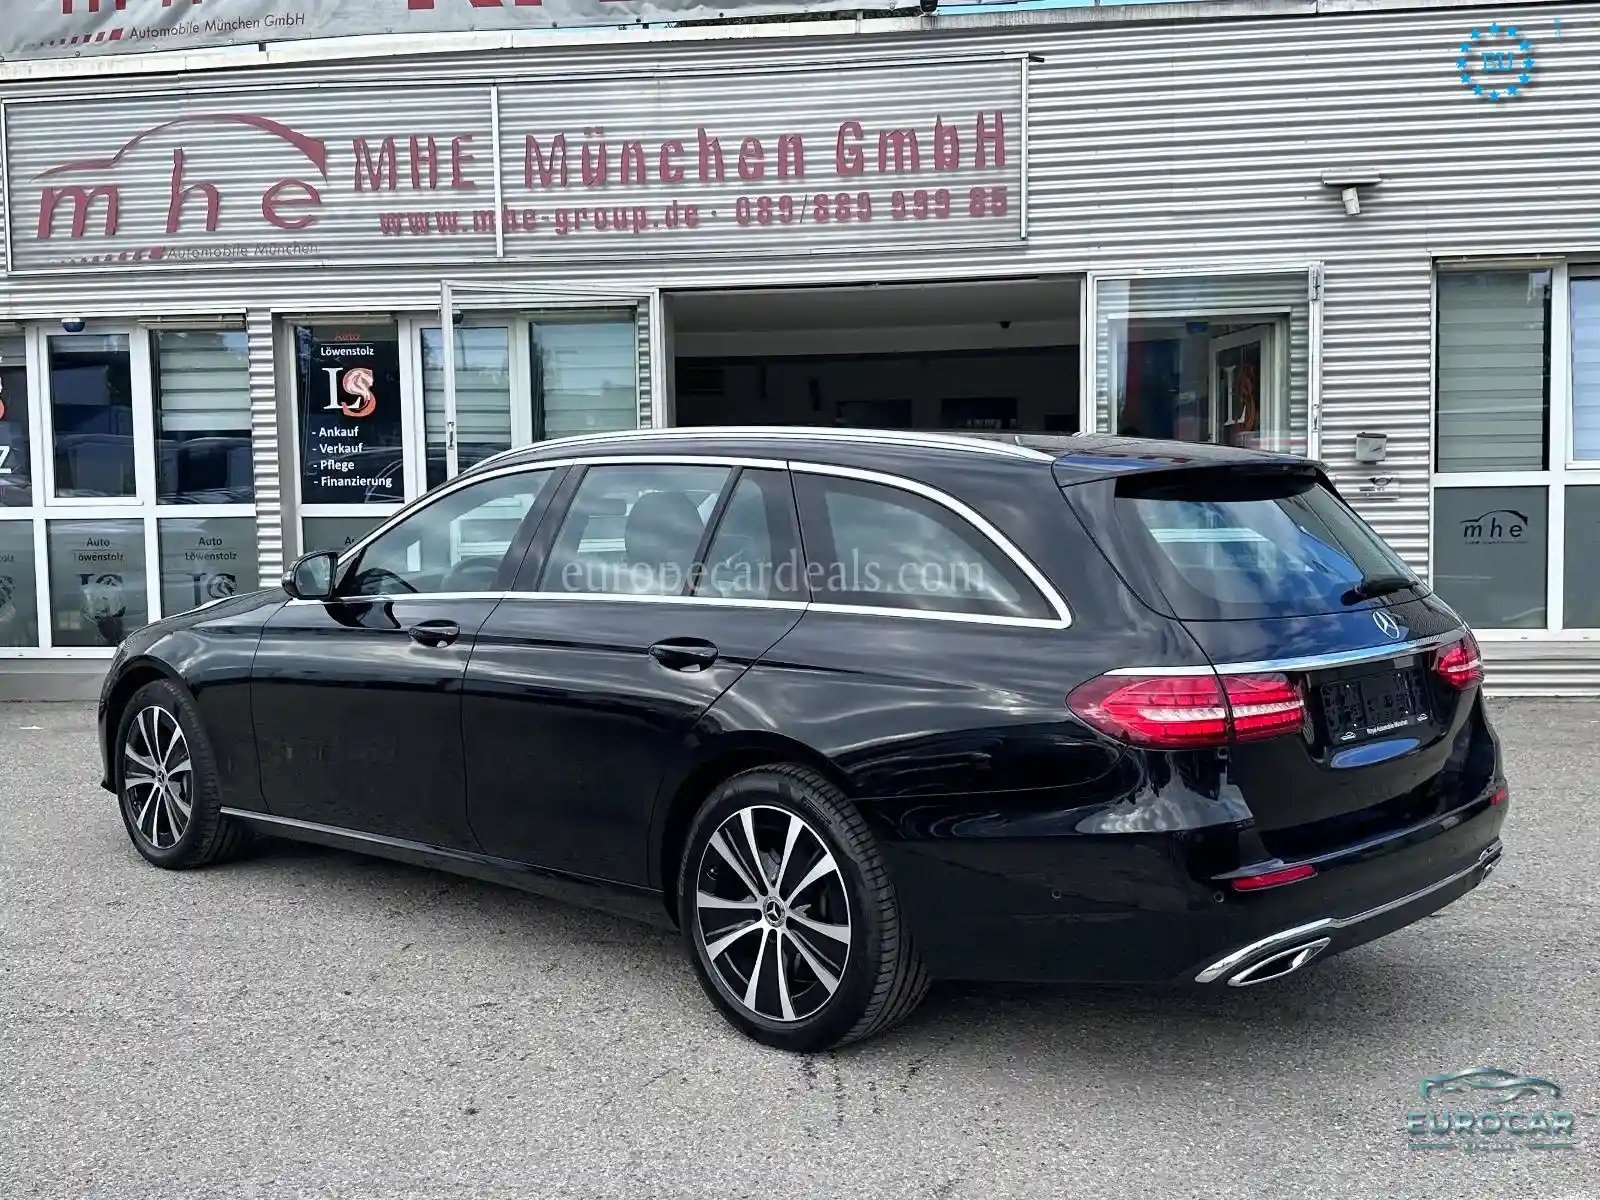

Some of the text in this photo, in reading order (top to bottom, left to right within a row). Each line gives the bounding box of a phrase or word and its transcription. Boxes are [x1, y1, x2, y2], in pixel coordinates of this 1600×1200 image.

[129, 14, 305, 39] Automobile München GmbH
[353, 110, 1006, 192] MHE München GmbH
[37, 147, 321, 240] mhe
[380, 200, 698, 235] www.mhe-group.de
[892, 189, 950, 220] 999
[969, 186, 1008, 217] 85
[168, 241, 319, 260] Automobile München
[321, 345, 374, 356] Löwenstolz
[319, 426, 359, 437] Ankauf
[320, 443, 363, 454] Verkauf
[321, 460, 355, 471] Pflege
[321, 476, 393, 491] Finanzierung
[1463, 517, 1522, 537] mhe
[87, 538, 110, 547] Auto
[199, 537, 222, 546] Auto
[185, 551, 237, 561] Löwenstolz
